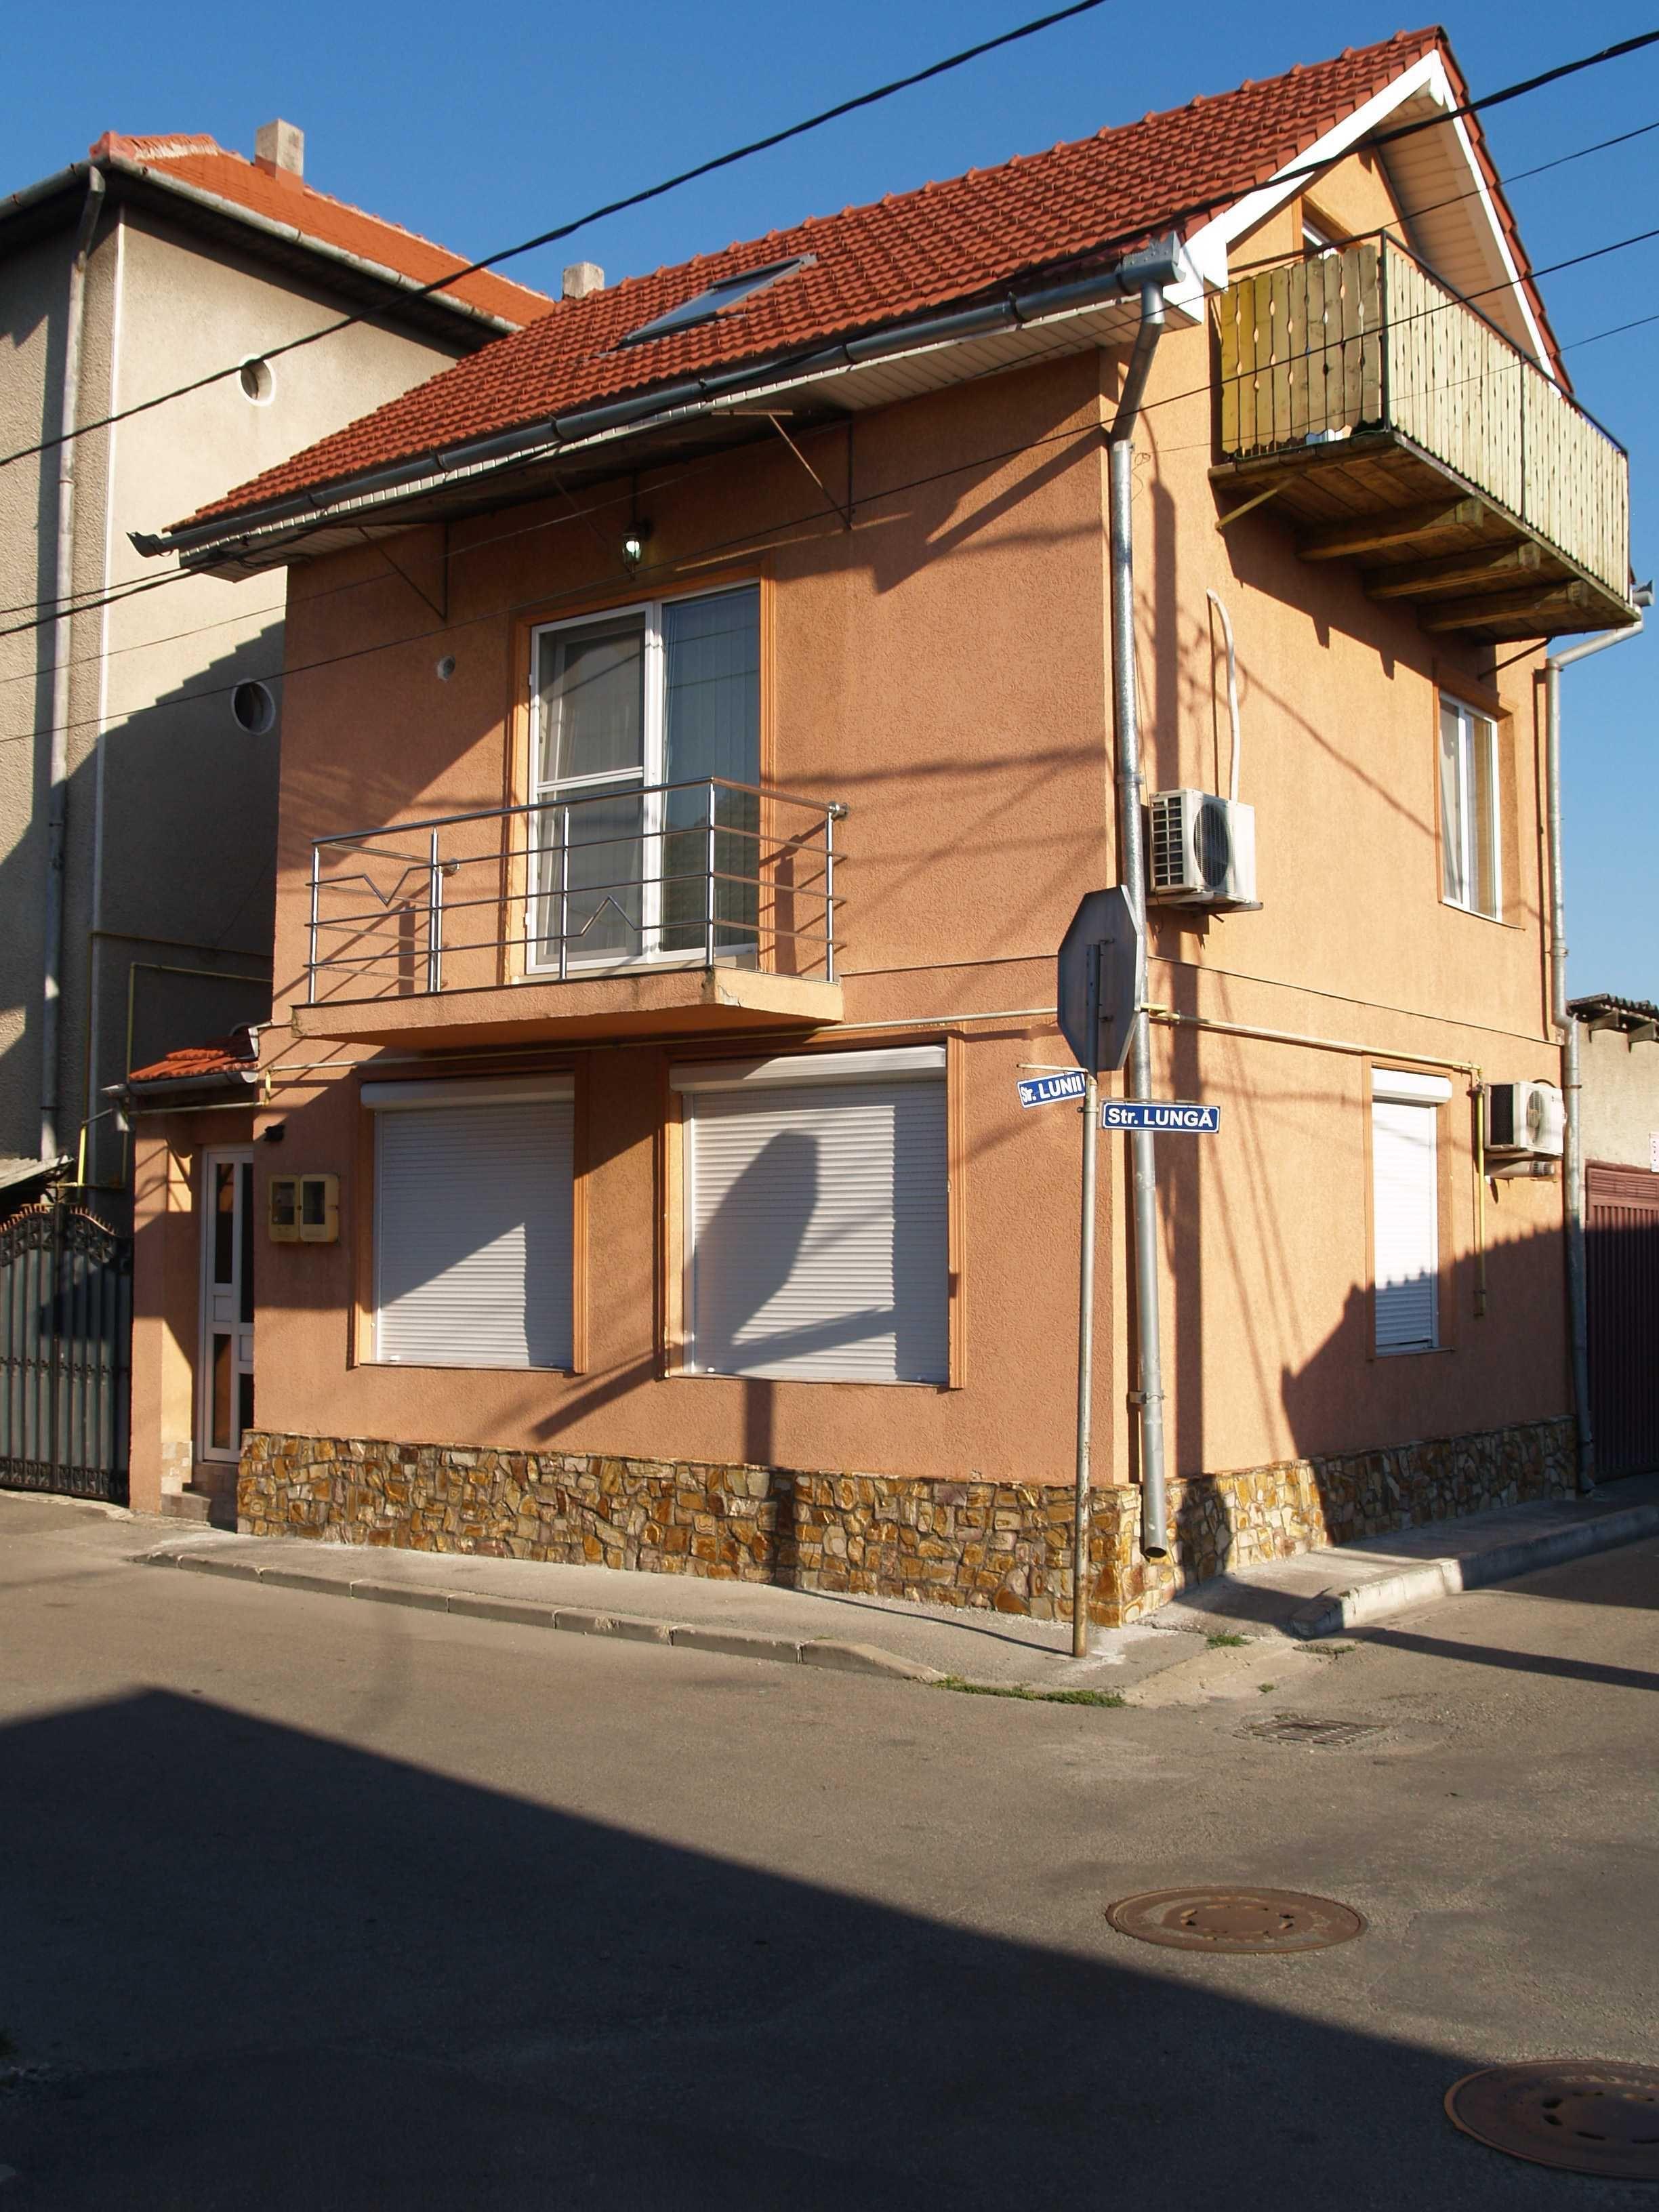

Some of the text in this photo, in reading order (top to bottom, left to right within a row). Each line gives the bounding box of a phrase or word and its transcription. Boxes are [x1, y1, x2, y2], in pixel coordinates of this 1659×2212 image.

[1021, 1076, 1082, 1103] Str. LUNII
[1107, 1107, 1213, 1127] Str. LUNGĂ
